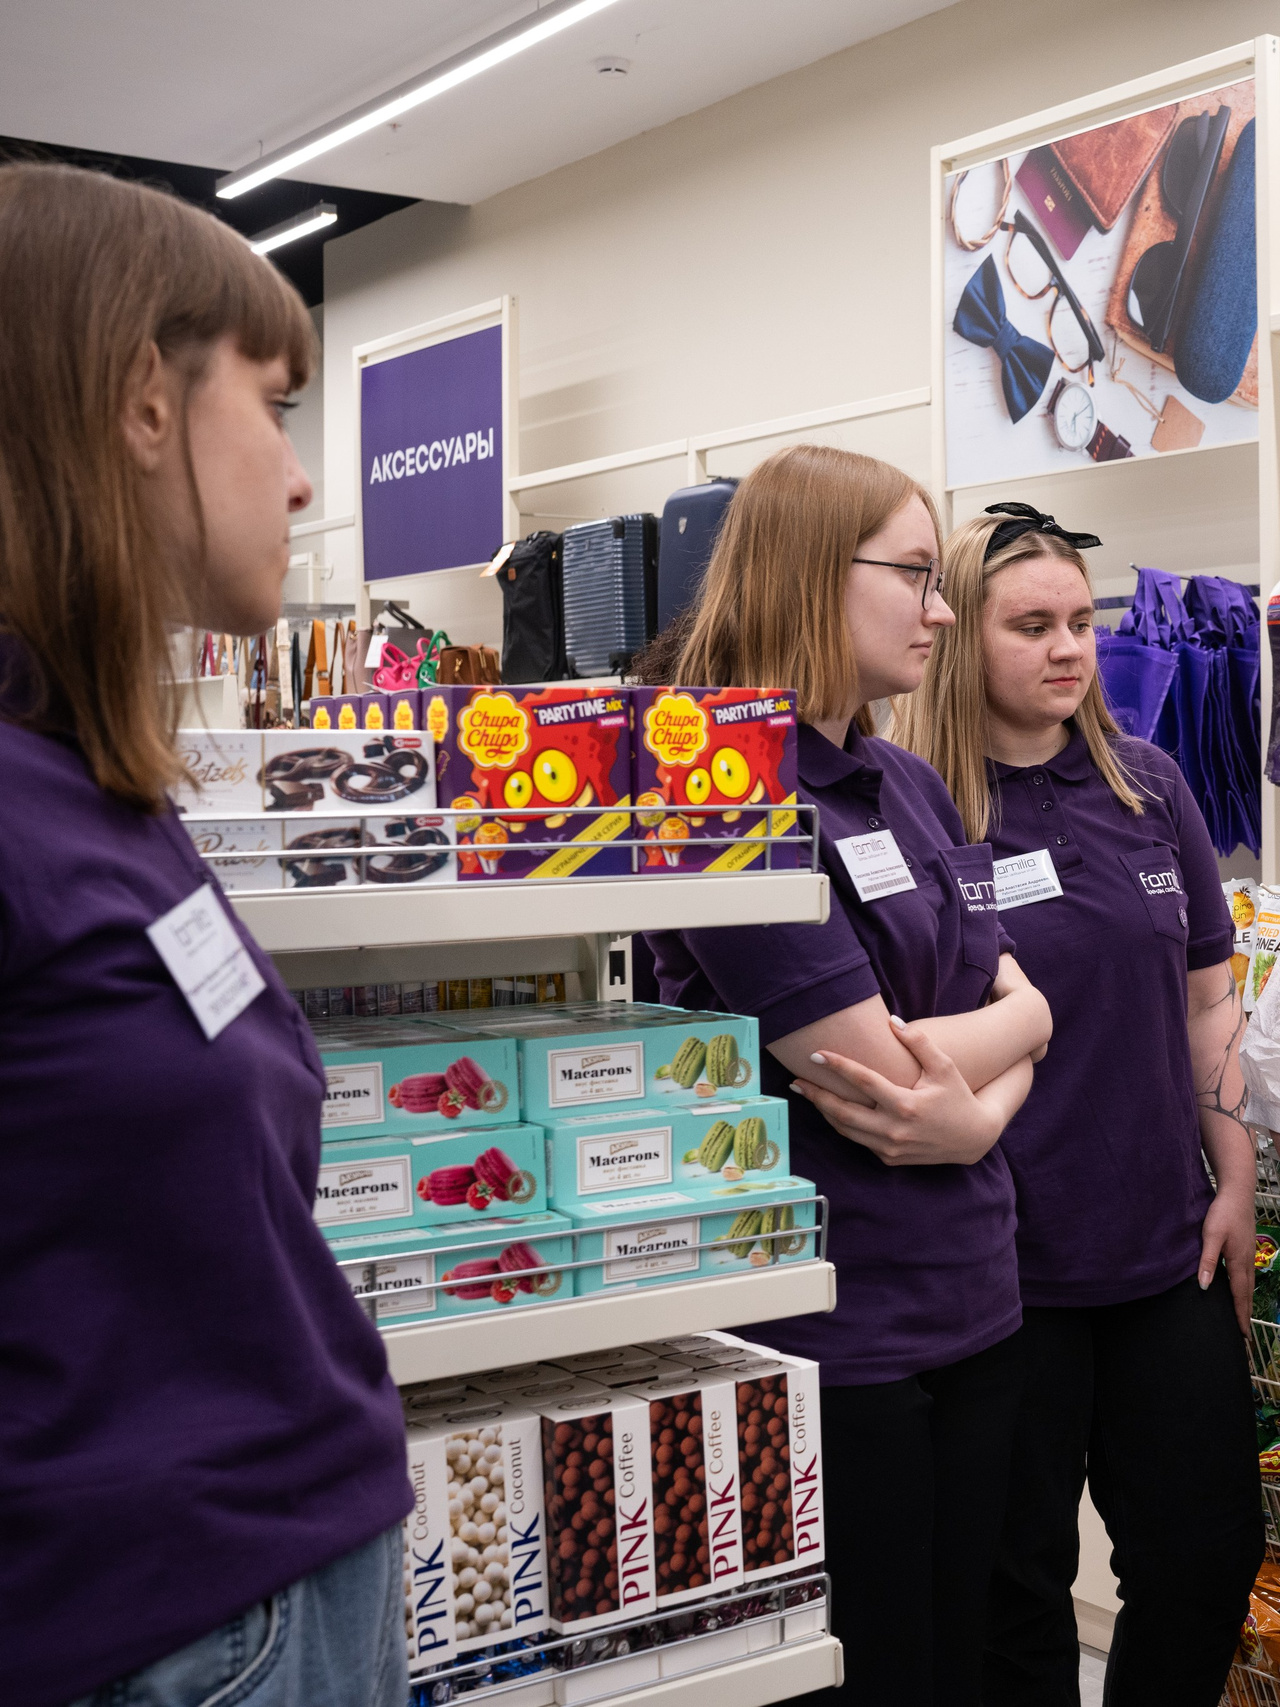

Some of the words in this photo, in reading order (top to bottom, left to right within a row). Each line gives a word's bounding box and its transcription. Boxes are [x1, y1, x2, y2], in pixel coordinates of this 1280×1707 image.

[370, 427, 494, 485] АКСЕССУАРЫ
[469, 710, 521, 734] Chupa
[538, 705, 577, 726] PARTY
[576, 698, 607, 719] TIME
[654, 710, 700, 731] Chupa
[715, 705, 750, 725] PARTY
[749, 698, 776, 718] TIME
[467, 728, 519, 757] Chups
[652, 727, 699, 755] Chups
[851, 838, 886, 855] familia
[560, 1065, 633, 1082] Macarons
[589, 1150, 660, 1169] Macarons
[316, 1181, 399, 1199] Macarons
[615, 1238, 688, 1257] Macarons
[707, 1409, 724, 1475] Coffee
[792, 1391, 806, 1455] Coffee
[509, 1437, 525, 1515] Coconut
[618, 1432, 635, 1498] Coffee
[411, 1460, 429, 1541] Coconut
[792, 1453, 820, 1558] PINK
[708, 1473, 739, 1583] PINK
[509, 1512, 544, 1627] PINK
[618, 1497, 650, 1609] PINK
[411, 1538, 449, 1658] PINK
